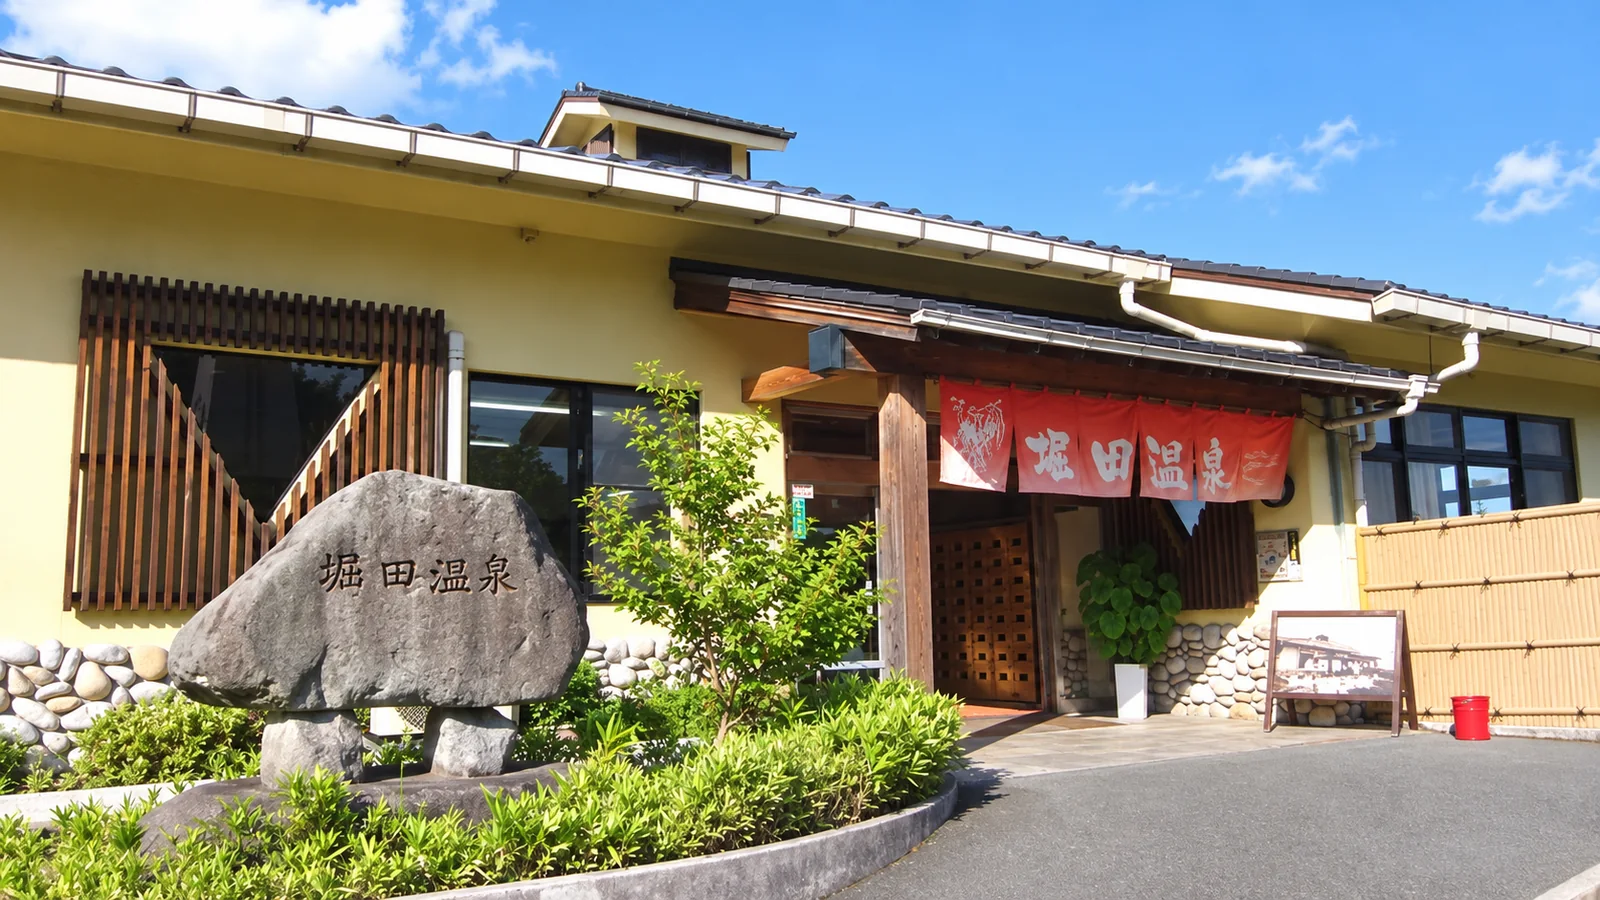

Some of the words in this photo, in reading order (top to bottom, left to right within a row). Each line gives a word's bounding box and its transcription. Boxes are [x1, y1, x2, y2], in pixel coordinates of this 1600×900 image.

[1025, 428, 1231, 495] 堀田温泉
[319, 552, 517, 595] 堀田温泉
